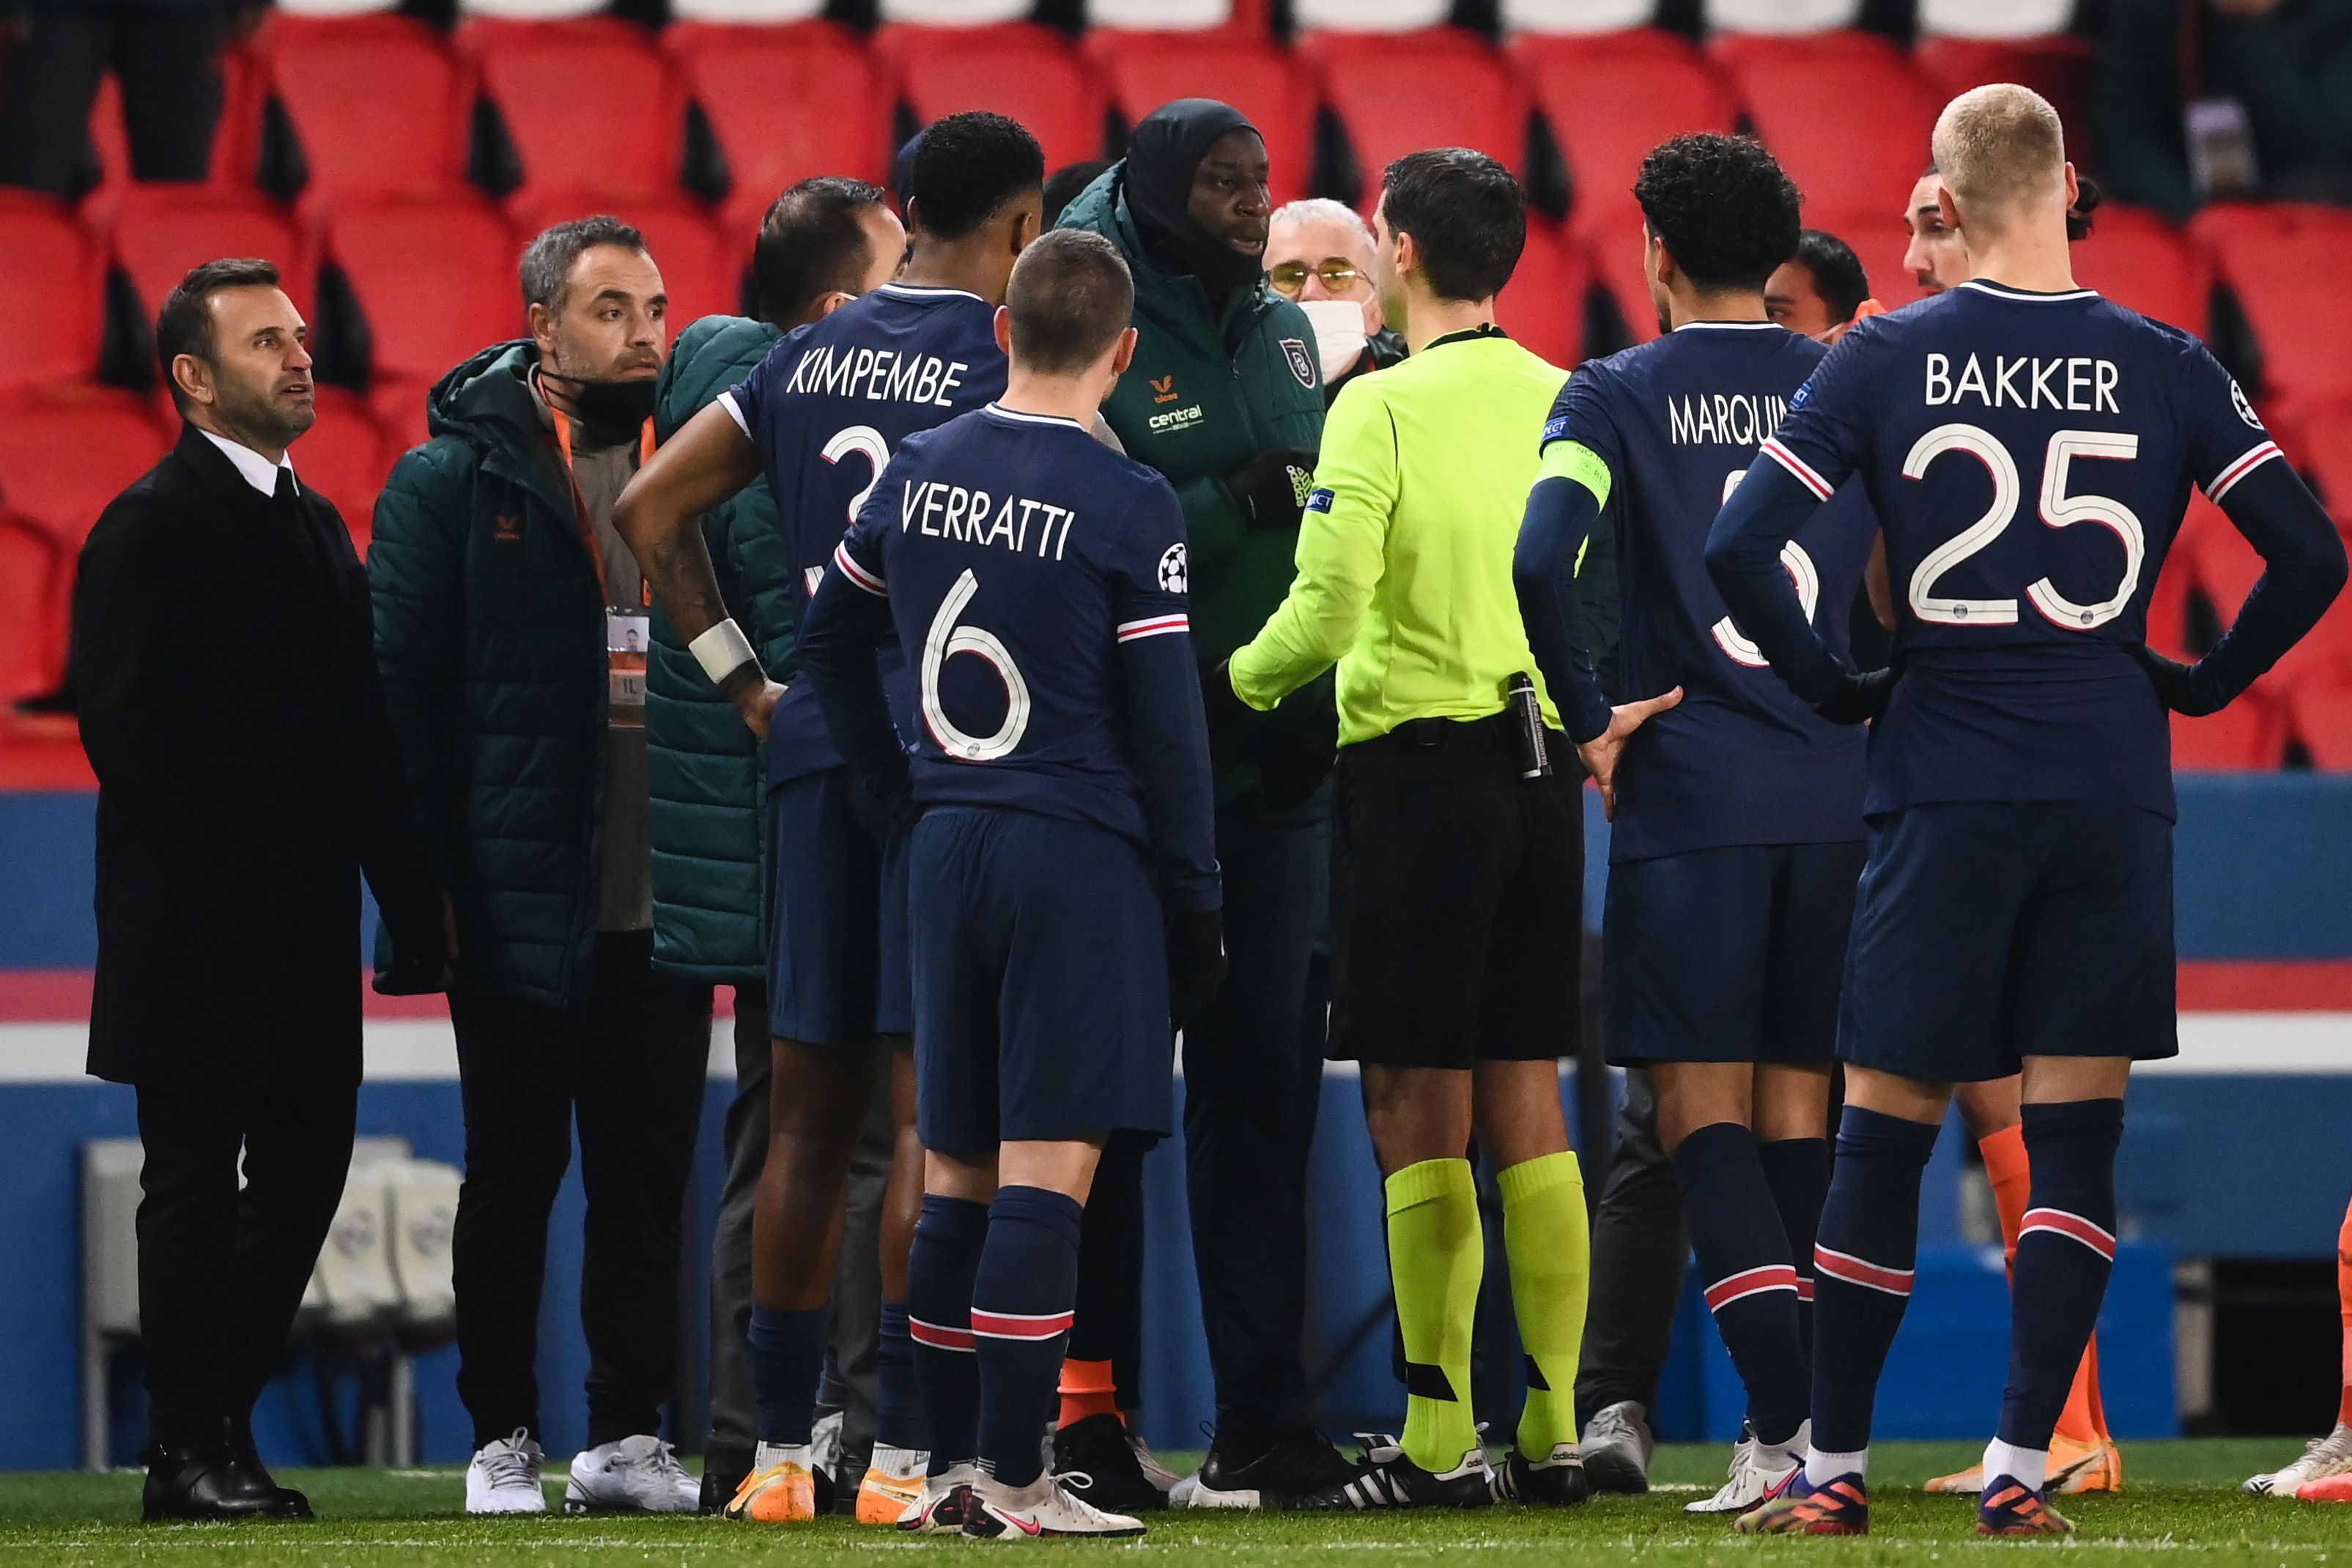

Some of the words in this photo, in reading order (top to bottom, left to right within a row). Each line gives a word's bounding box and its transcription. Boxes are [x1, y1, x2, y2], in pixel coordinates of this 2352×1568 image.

[785, 344, 969, 407] KIMPEMBE
[1925, 351, 2120, 414] BAKKER
[1148, 404, 1202, 428] central
[1285, 465, 1306, 508] adidas
[902, 479, 1076, 561] VERRATTI
[1901, 423, 2145, 632] 25
[921, 567, 1032, 762] 6
